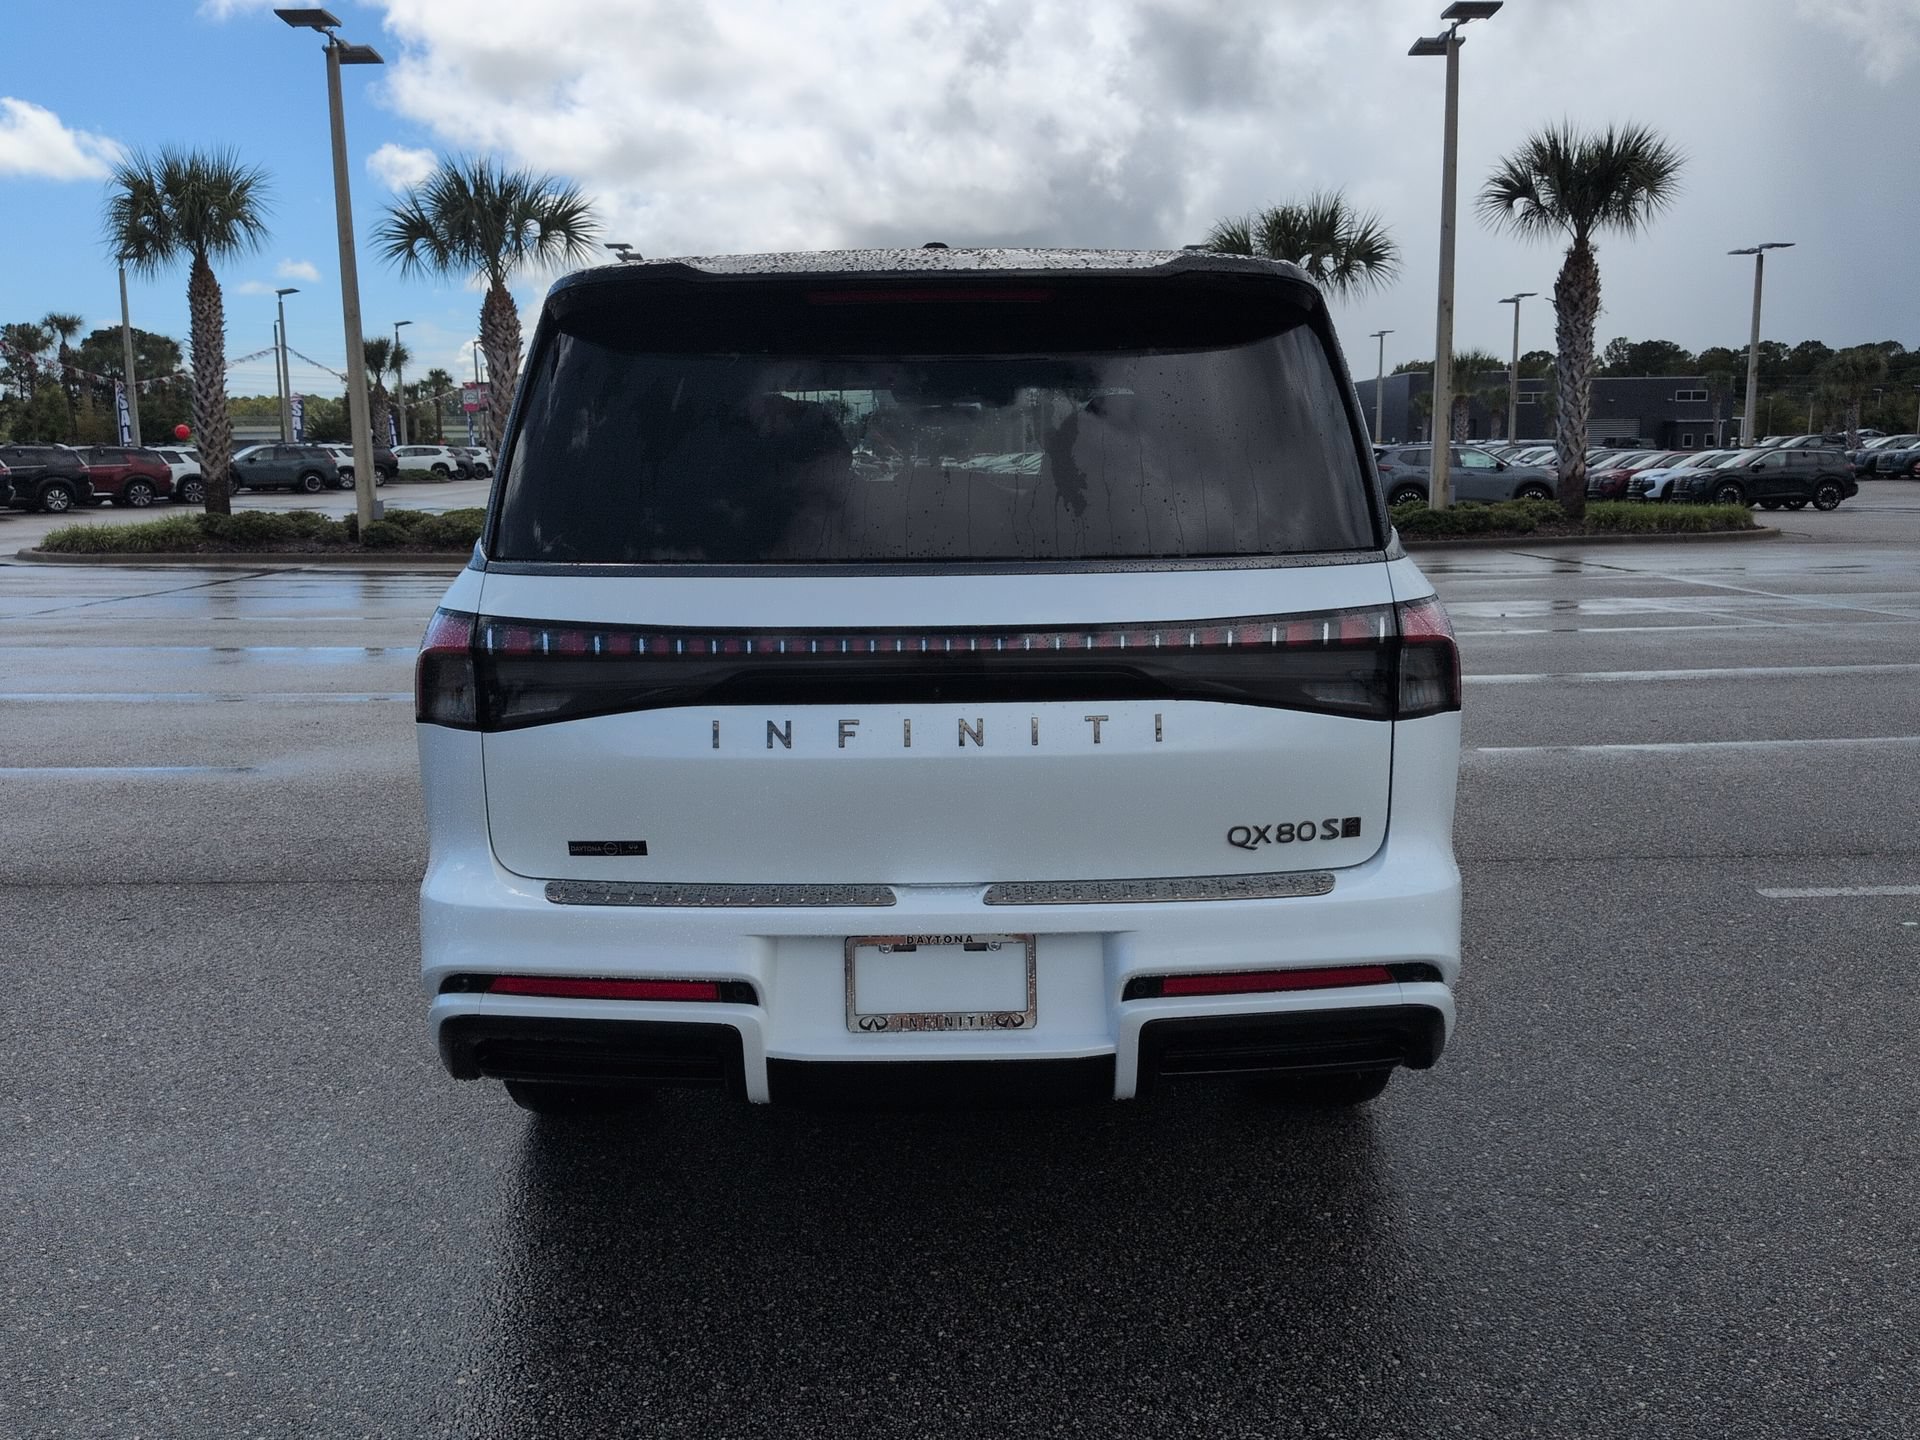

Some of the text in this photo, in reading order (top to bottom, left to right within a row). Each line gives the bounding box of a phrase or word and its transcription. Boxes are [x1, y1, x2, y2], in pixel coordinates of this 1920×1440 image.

[291, 403, 302, 443] SAL
[711, 713, 1163, 750] INFINITI
[906, 934, 974, 945] DAYTONA
[899, 1015, 985, 1028] INFINITI
